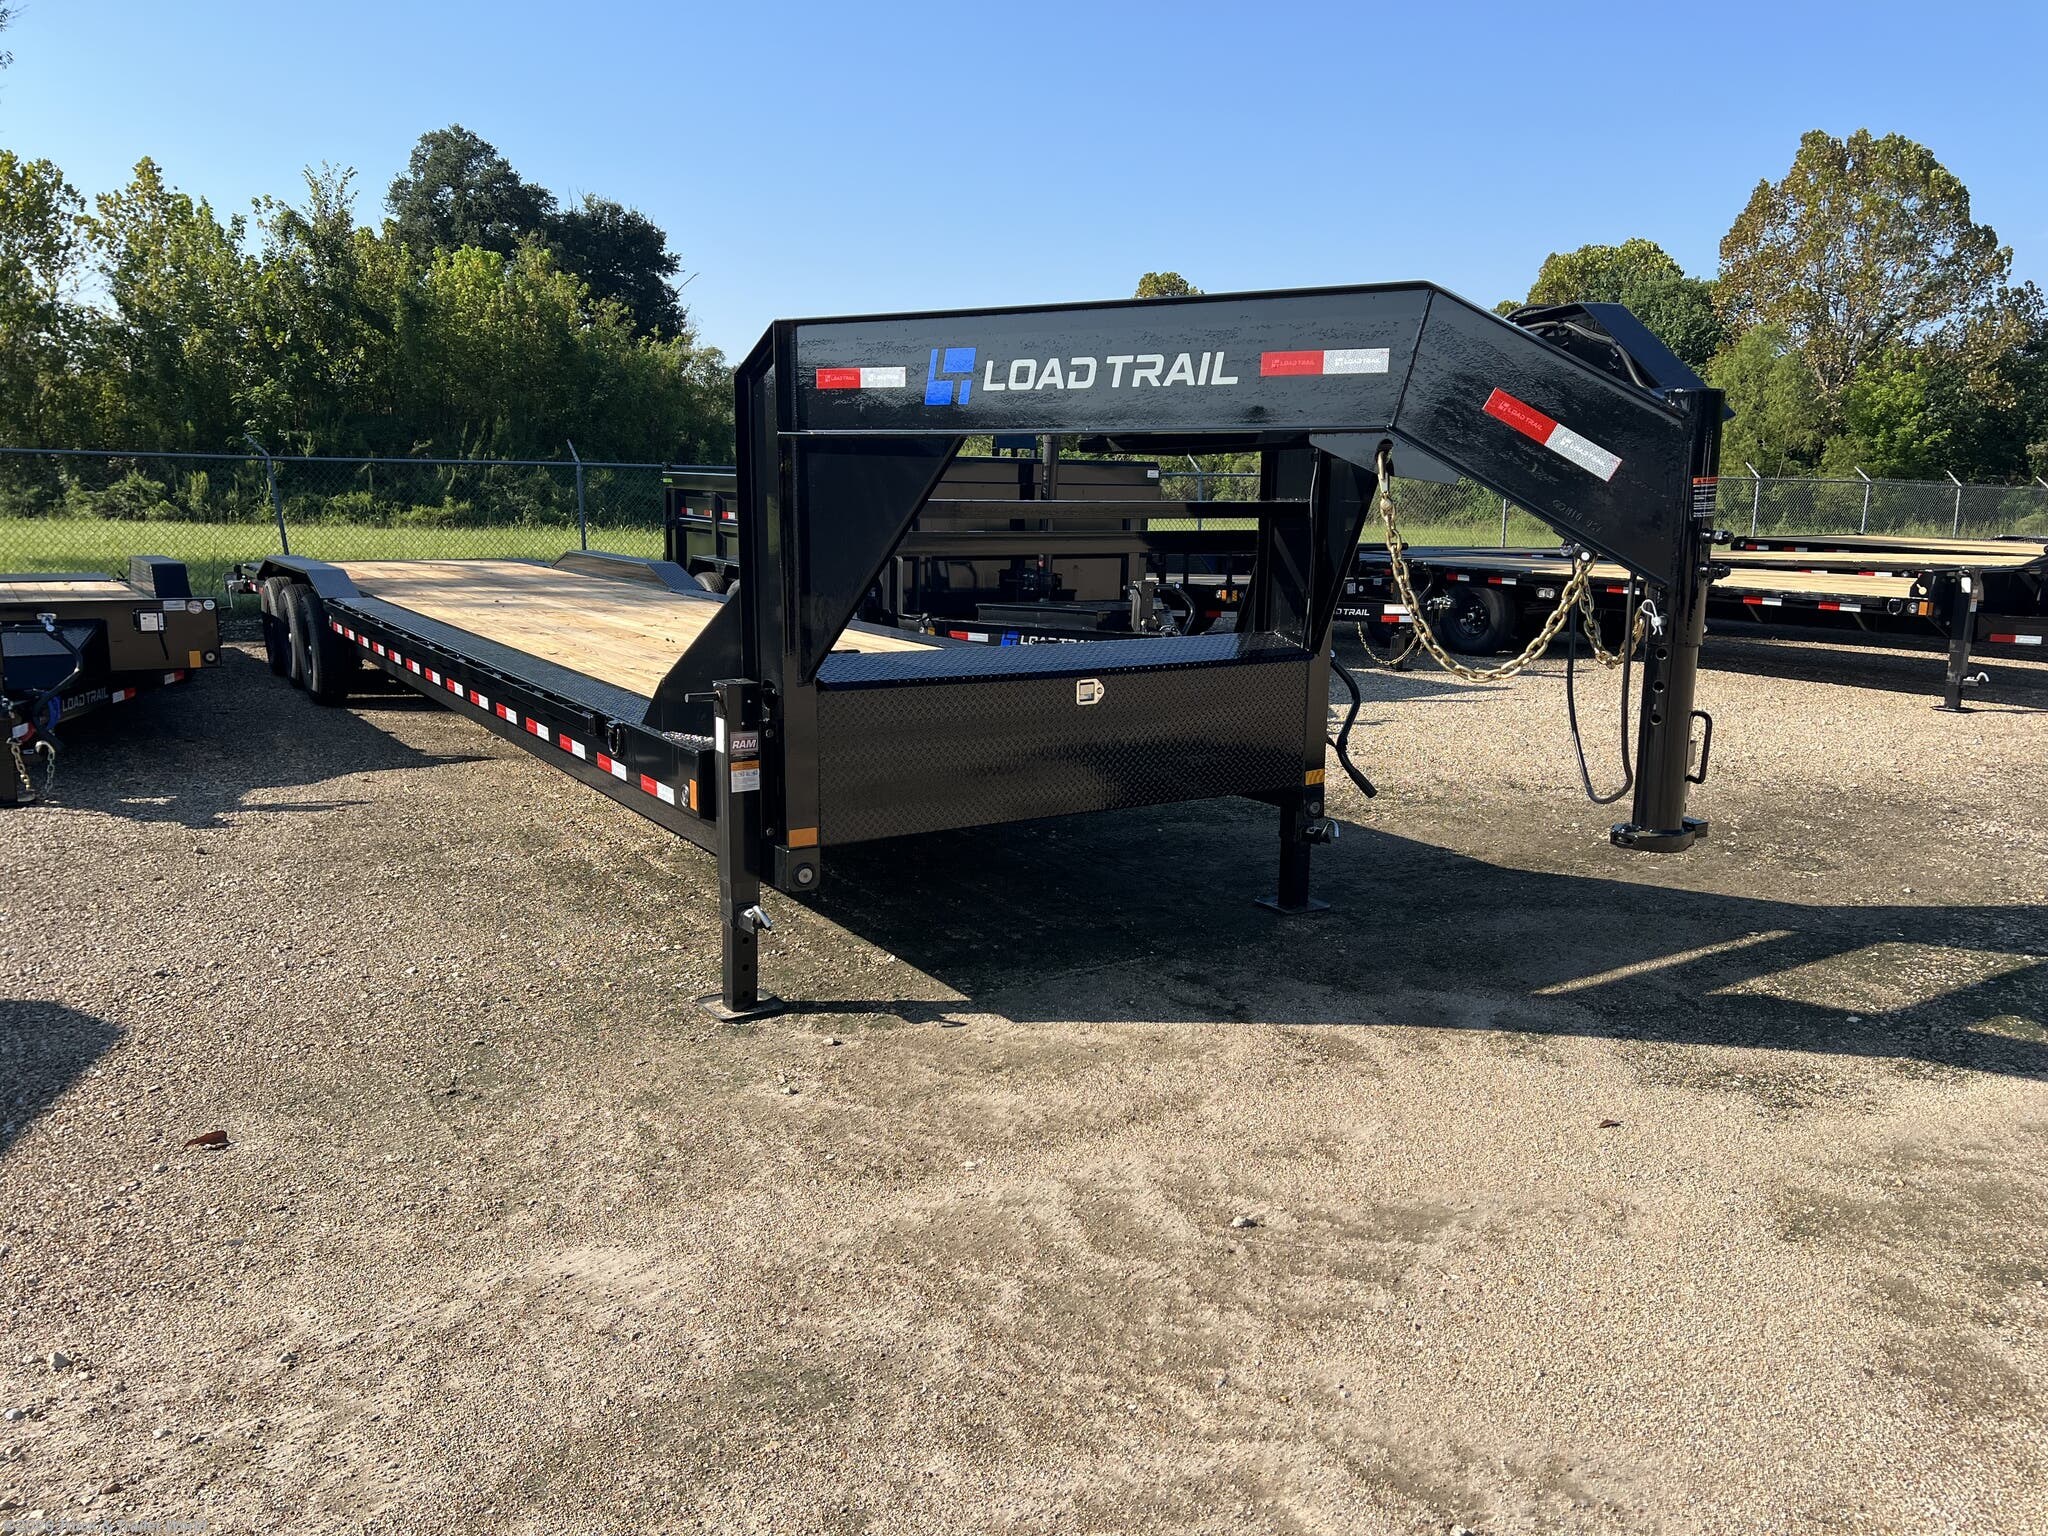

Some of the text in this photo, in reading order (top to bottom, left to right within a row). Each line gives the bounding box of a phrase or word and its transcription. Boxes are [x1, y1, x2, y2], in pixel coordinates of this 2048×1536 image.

[983, 351, 1239, 391] LOAD TRAIL
[1507, 407, 1543, 431] LOAD TRAIL
[1344, 608, 1370, 616] TRAIL
[62, 687, 109, 712] LOAD TRAIL
[732, 739, 757, 750] RAM
